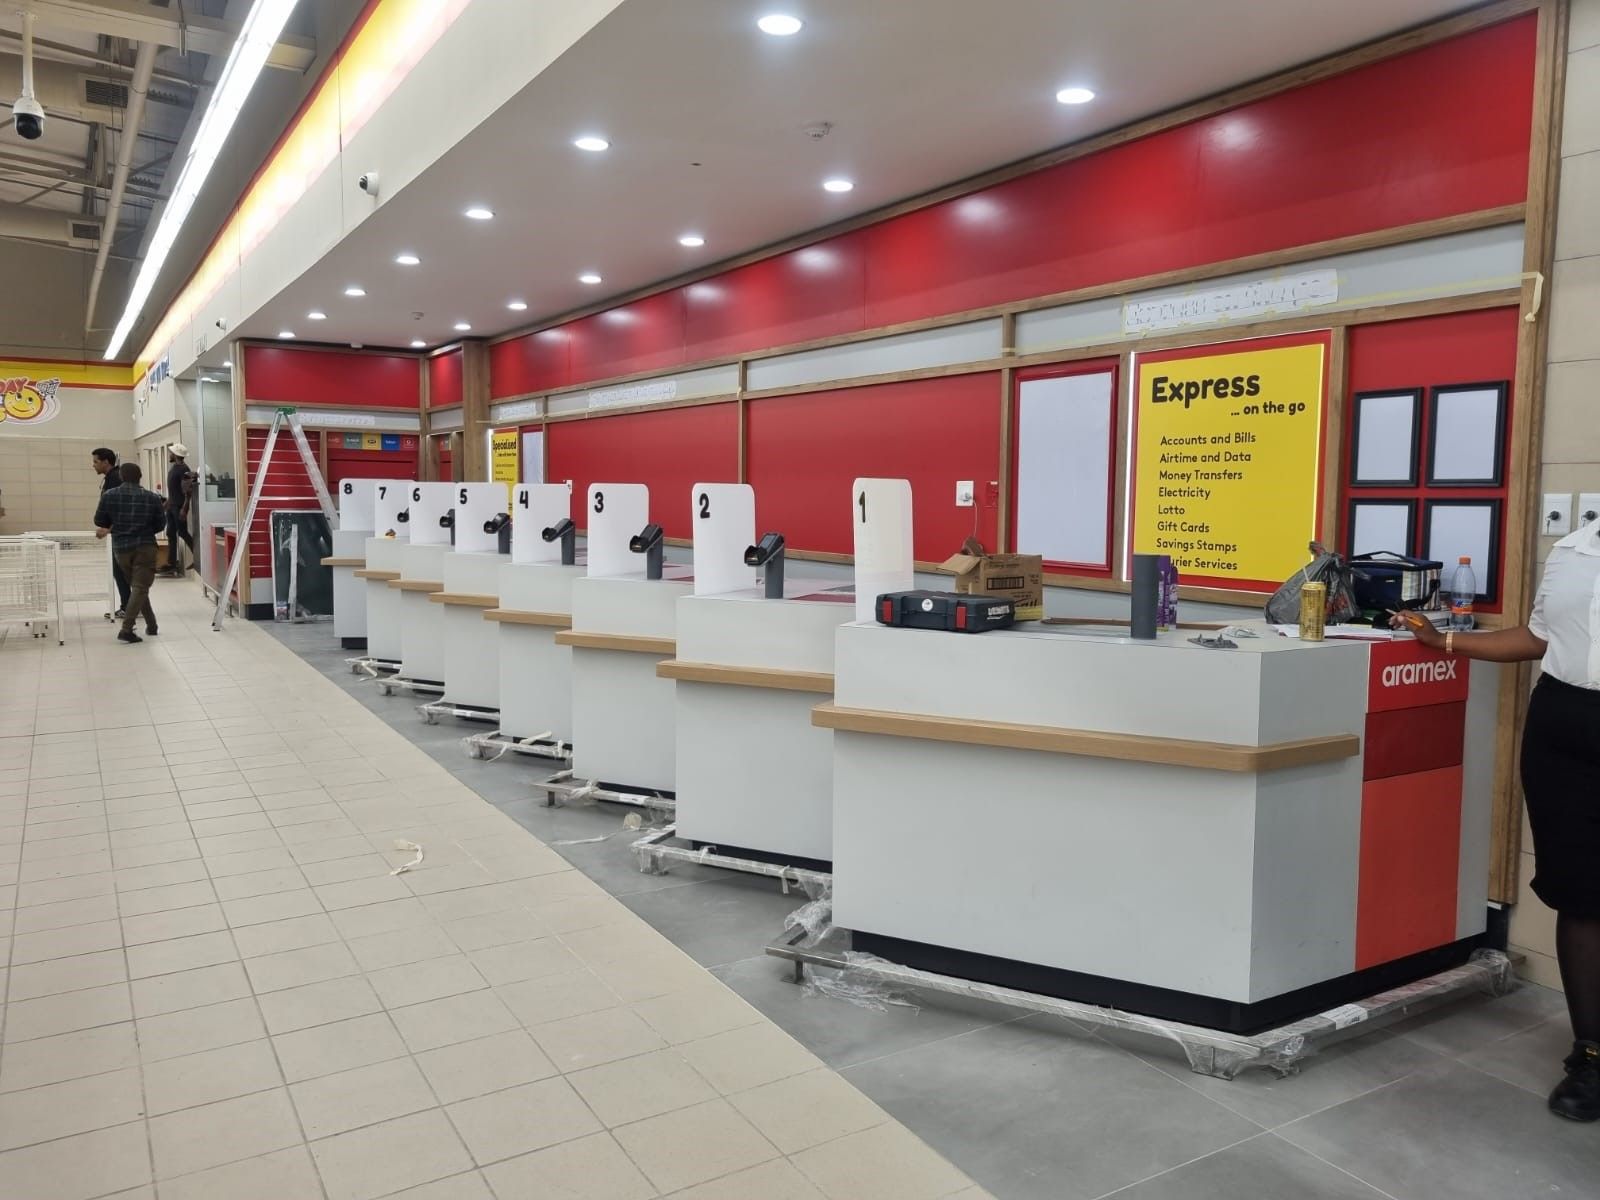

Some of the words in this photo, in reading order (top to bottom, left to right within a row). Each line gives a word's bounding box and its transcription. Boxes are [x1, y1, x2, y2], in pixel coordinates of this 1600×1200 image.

[1151, 374, 1260, 408] Express
[1243, 405, 1259, 415] on
[1262, 402, 1285, 414] the
[1288, 401, 1306, 416] go
[1160, 434, 1207, 446] Accounts
[1210, 432, 1231, 445] and
[1234, 432, 1256, 444] Bills
[1159, 452, 1197, 464] Airtime
[1200, 451, 1220, 463] and
[1223, 451, 1252, 463] Data
[1159, 470, 1192, 483] Money
[1194, 468, 1243, 481] Transfers
[343, 483, 353, 495] 8
[378, 487, 387, 500] 7
[412, 488, 421, 502] 6
[1158, 486, 1211, 500] Electricity
[459, 489, 468, 505] 5
[519, 490, 529, 510] 4
[594, 491, 604, 514] 3
[699, 493, 711, 519] 2
[858, 491, 866, 524] 1
[1158, 505, 1185, 515] Lotto
[1157, 521, 1177, 533] Gift
[1180, 521, 1210, 533] Cards
[1156, 538, 1195, 552] Savings
[1197, 540, 1237, 554] Stamps
[1194, 558, 1238, 570] Services
[1382, 660, 1457, 687] aramex
